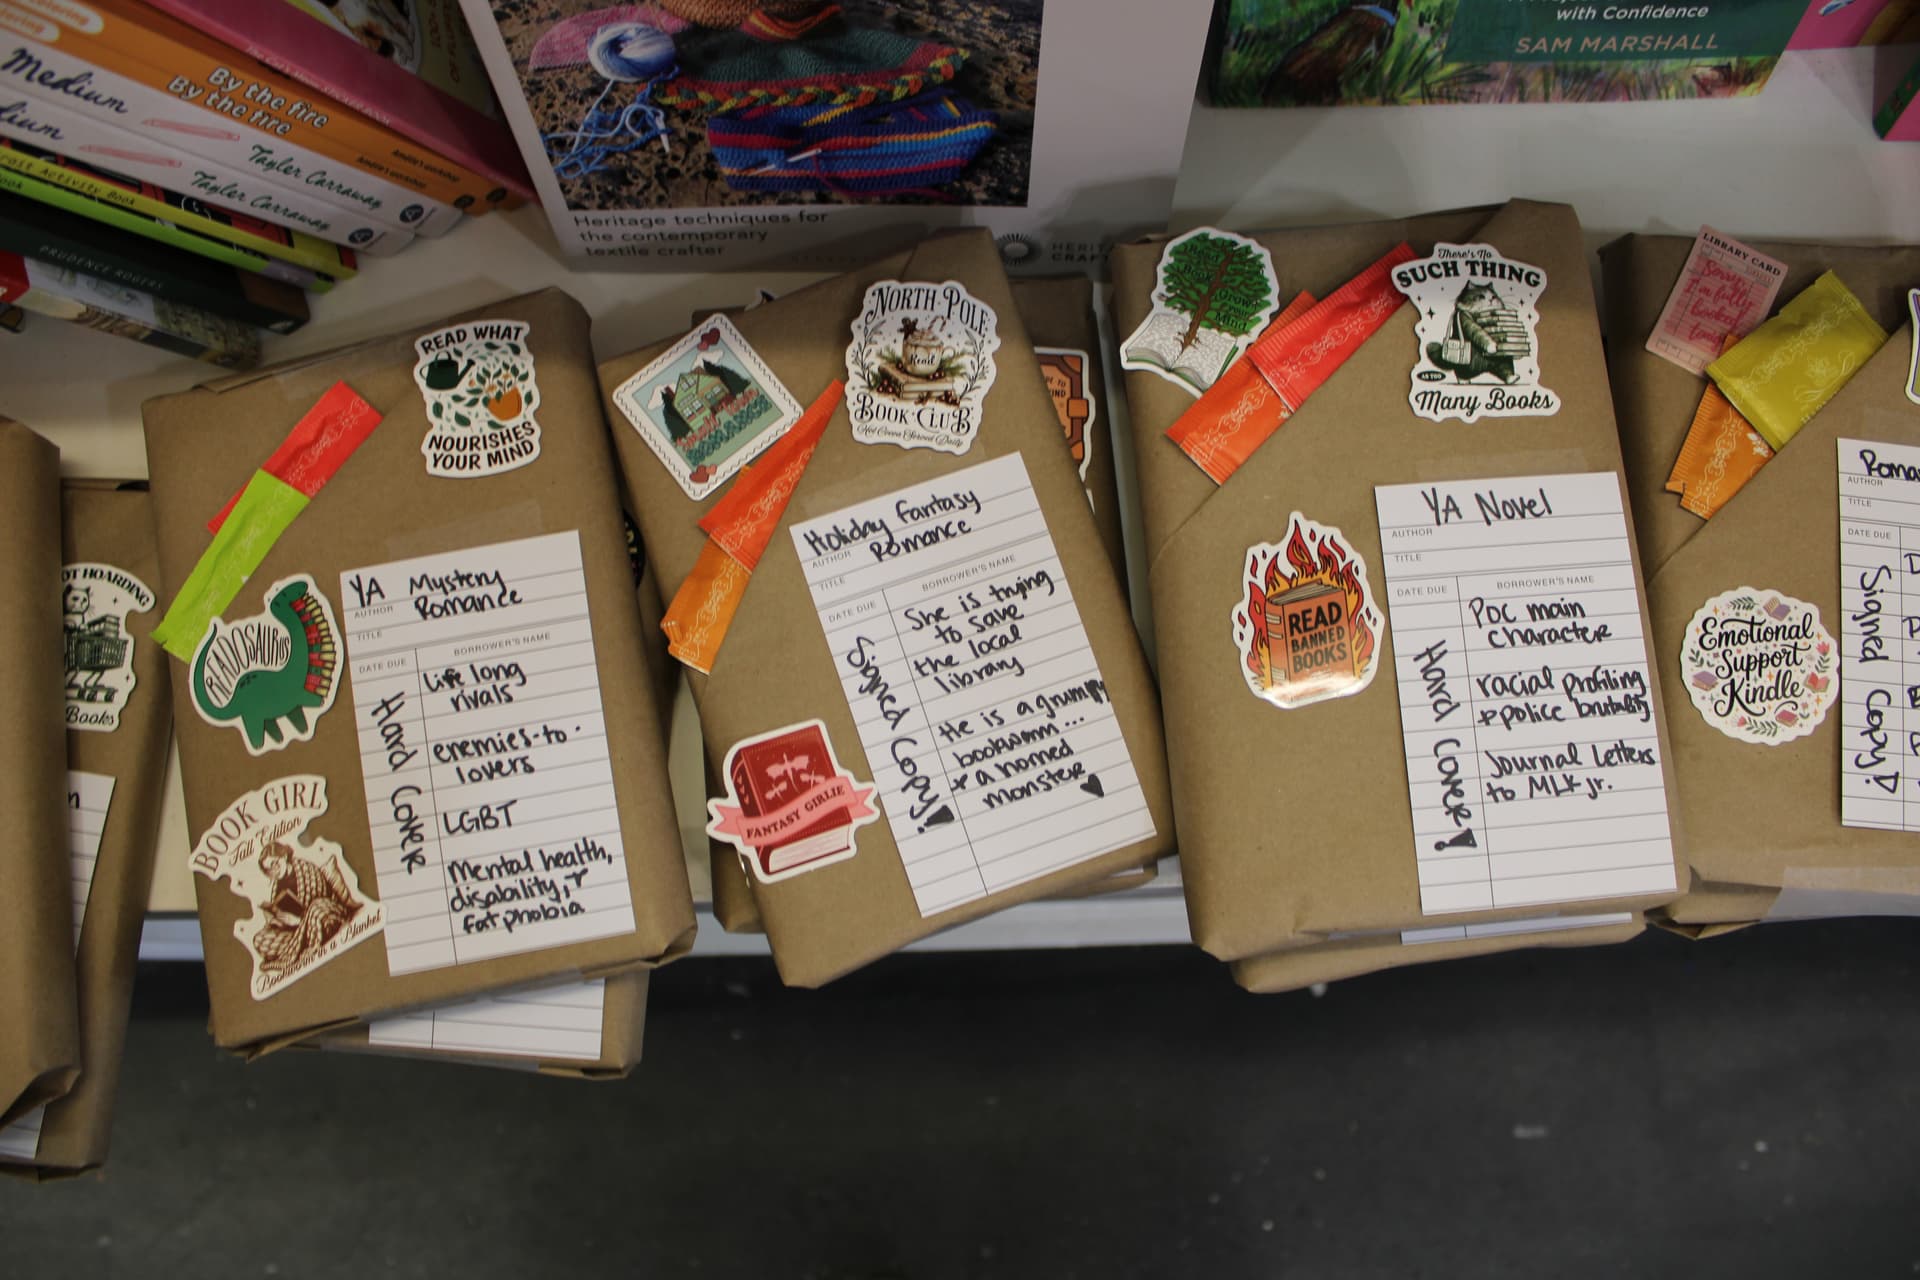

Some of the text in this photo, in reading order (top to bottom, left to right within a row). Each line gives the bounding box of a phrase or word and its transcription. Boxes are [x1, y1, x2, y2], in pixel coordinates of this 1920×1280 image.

[1557, 5, 1709, 21] with Confidence
[1515, 34, 1719, 54] SAM MARSHALL
[1, 47, 129, 115] Medium
[168, 74, 292, 137] By the fire
[208, 66, 243, 93] By
[243, 83, 284, 111] the
[286, 101, 329, 130] fire
[305, 171, 384, 210] Carraway
[250, 196, 331, 232] Carraway
[574, 210, 828, 231] Heritage techniques for
[579, 229, 768, 242] the contemporary
[586, 244, 725, 257] textile crafter
[1438, 248, 1492, 260] There's No
[1703, 232, 1749, 261] LIBRARY
[1751, 257, 1781, 277] CARD
[1397, 260, 1541, 288] SUCH THING
[865, 285, 988, 338] NORTH POLE
[1215, 311, 1247, 331] Mind
[421, 325, 524, 354] READ WHAT
[1415, 387, 1554, 417] Many Books
[428, 421, 536, 452] NOURISHES
[433, 440, 534, 471] YOUR MIND
[1848, 476, 1883, 487] AUTHOR
[1421, 487, 1553, 526] YA Novel
[1848, 498, 1872, 508] TITLE
[804, 517, 893, 557] Holiday
[869, 519, 972, 562] Romance
[1391, 528, 1433, 538] AUTHOR
[1848, 528, 1891, 540] DATE DUE
[811, 550, 852, 569] AUTHOR
[921, 554, 1017, 593] BORROWER'S NAME
[1395, 554, 1422, 563] TITLE
[82, 567, 150, 606] HOARDING
[349, 569, 507, 608] YA Mystery
[819, 577, 846, 592] TITLE
[1396, 585, 1448, 598] DATE DUE
[1496, 575, 1595, 590] BORROWER'S NAME
[354, 605, 394, 619] AUTHOR
[414, 588, 523, 621] Romance
[828, 601, 877, 623] DATE DUE
[904, 569, 1055, 631] She is trying
[1526, 597, 1586, 623] main
[1852, 565, 1892, 663] Signed
[934, 624, 963, 644] to
[1288, 601, 1343, 637] READ
[1699, 612, 1815, 652] Emotional
[357, 630, 383, 642] TITLE
[453, 631, 552, 657] BORROWER'S NAME
[914, 624, 1022, 678] the local
[1291, 625, 1345, 654] BANNED
[205, 622, 290, 706] READOSAURUS
[358, 658, 408, 674] DATE DUE
[470, 661, 527, 687] long
[1292, 643, 1348, 674] BOOKS
[1715, 642, 1812, 681] Support
[846, 635, 911, 731] Signed
[934, 656, 1025, 694] library
[1413, 640, 1461, 722] Hard
[1476, 665, 1648, 701] racial profiling
[450, 683, 514, 712] rivals
[1714, 669, 1804, 717] Kindle
[66, 705, 115, 725] Books
[939, 719, 974, 744] He
[980, 709, 1005, 729] is
[1017, 701, 1034, 716] a
[1499, 693, 1651, 731] police brutality
[371, 691, 418, 771] Hard
[455, 755, 536, 784] lovers
[1485, 741, 1583, 778] Journal
[975, 771, 995, 786] a
[1487, 773, 1580, 803] to MLK
[443, 800, 518, 835] LGBT
[746, 784, 846, 840] FANTASY GIRLIE
[194, 782, 322, 874] BOOK GIRL
[256, 815, 302, 844] Edition
